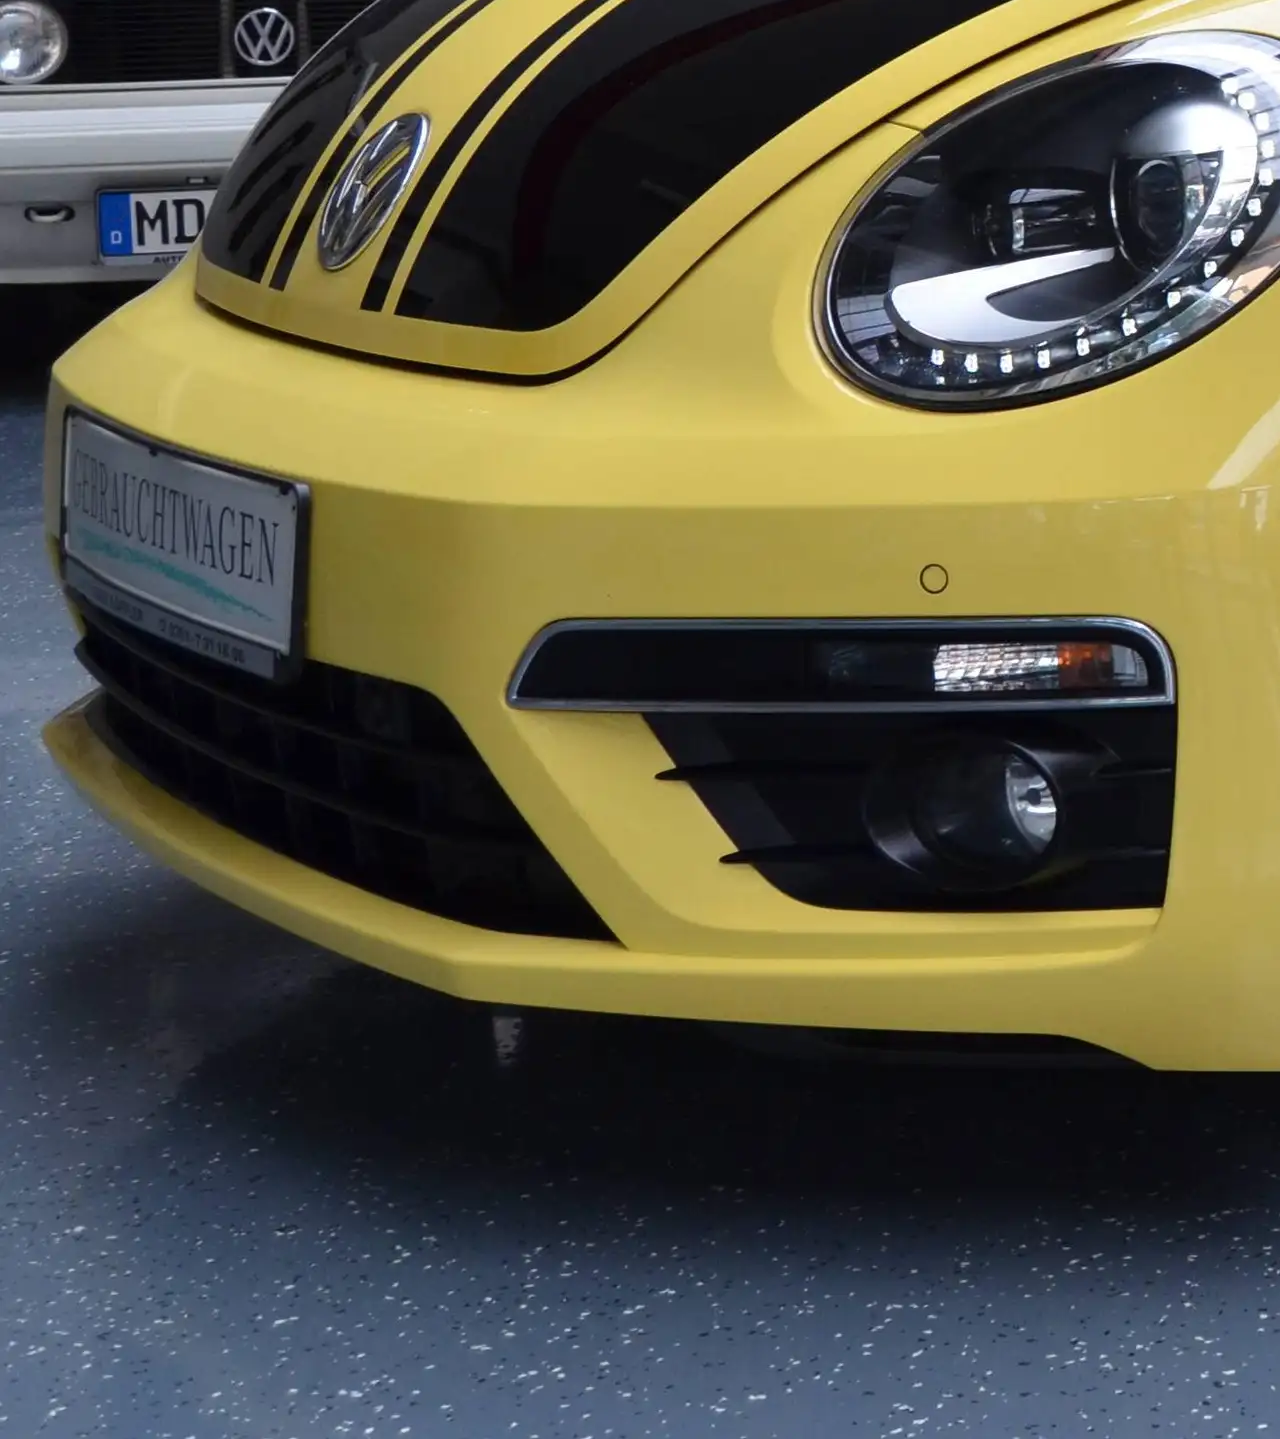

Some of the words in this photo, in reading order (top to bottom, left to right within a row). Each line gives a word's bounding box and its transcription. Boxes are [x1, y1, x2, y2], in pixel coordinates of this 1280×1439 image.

[235, 8, 294, 66] VW
[110, 230, 122, 245] D
[135, 198, 206, 247] MD
[73, 448, 280, 587] GEBRAUCHTWAGEN
